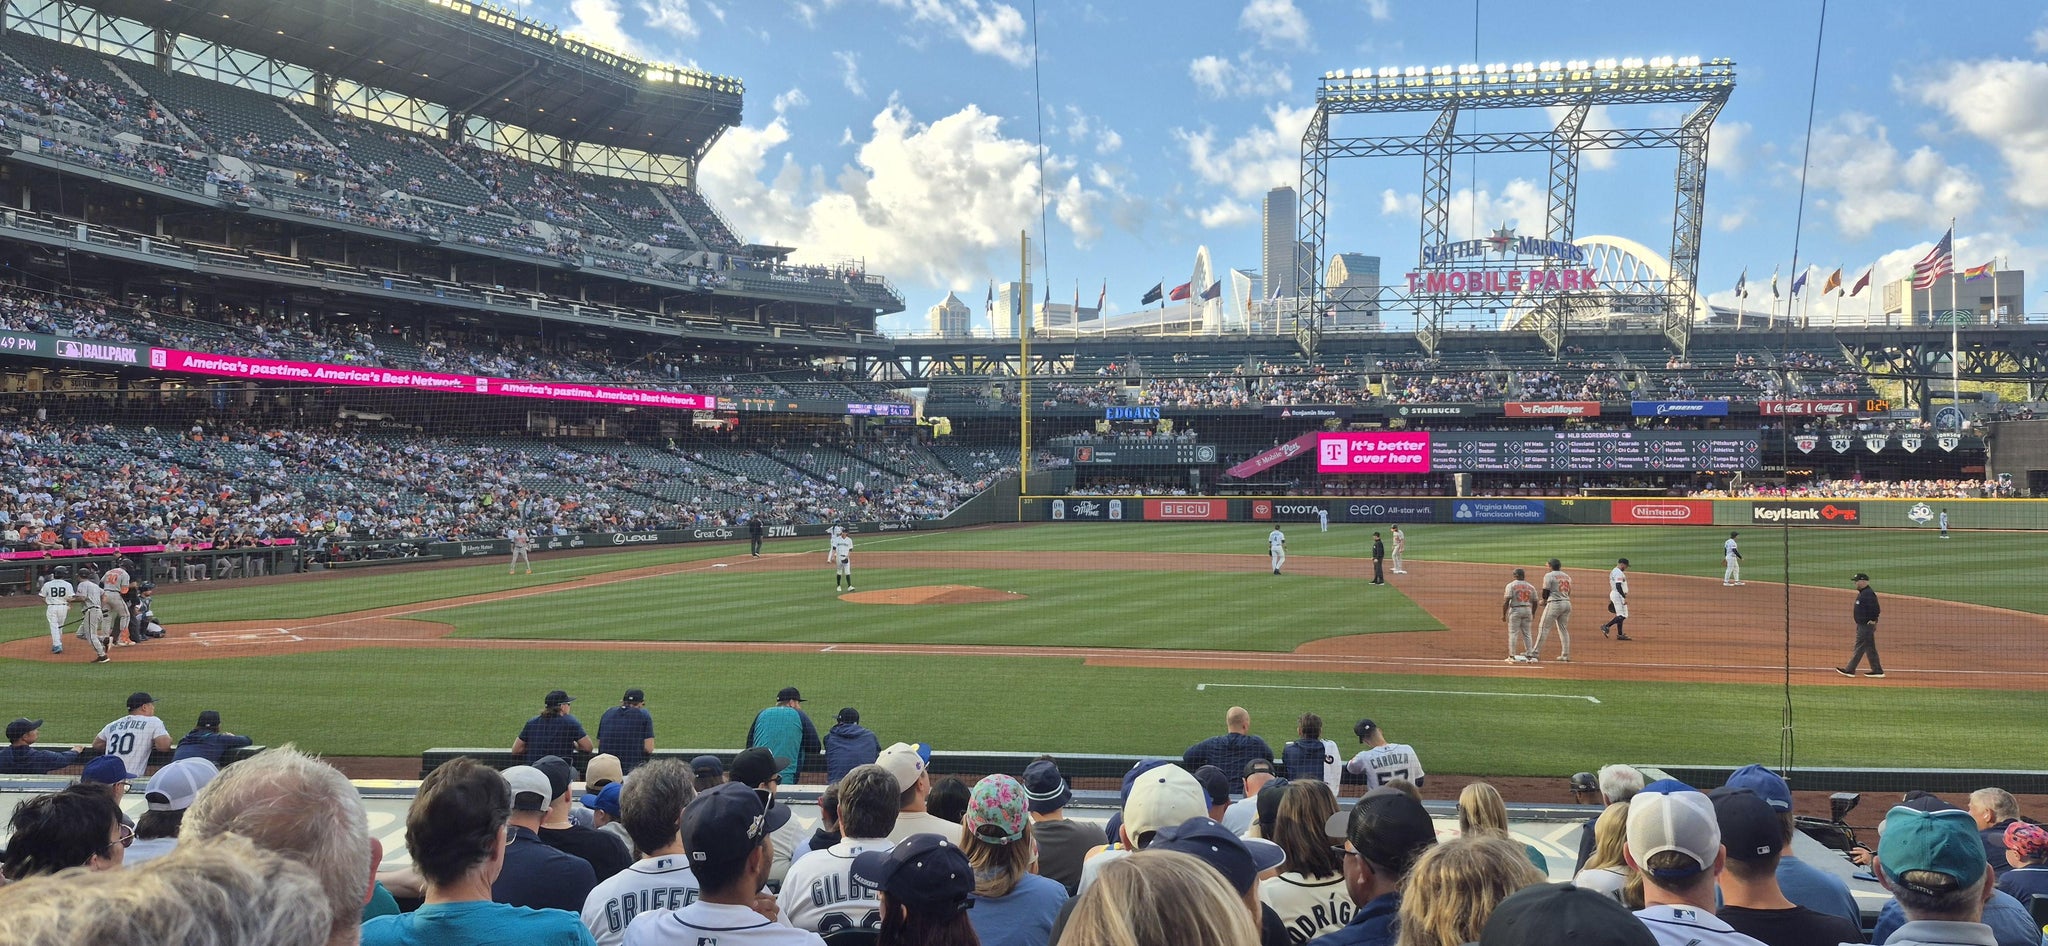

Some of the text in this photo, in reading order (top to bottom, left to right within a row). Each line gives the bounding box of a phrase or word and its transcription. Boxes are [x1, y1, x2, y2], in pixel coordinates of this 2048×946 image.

[1423, 235, 1585, 265] SEATTLE MARINERS
[770, 274, 809, 284] Trident Deck
[1404, 268, 1599, 294] T-MOBILE PARK
[18, 338, 37, 351] PM
[83, 343, 137, 363] BALLPARK
[183, 355, 464, 389] America's pastime. America's Best Network.
[501, 383, 697, 406] America's pastime. America's Best Network.
[1106, 407, 1160, 419] EDGARS
[1815, 403, 1846, 413] Coca-Cola
[1351, 440, 1426, 451] It's better
[1800, 441, 1813, 449] 42
[1835, 441, 1847, 449] 24
[1906, 440, 1917, 448] 51
[1943, 438, 1955, 447] 51
[1353, 453, 1423, 464] over here
[1164, 506, 1207, 515] BECU
[1275, 505, 1319, 514] TOYOTA
[1350, 505, 1385, 515] eero
[1754, 507, 1819, 521] KeyBank
[694, 528, 733, 540] Great Clips
[768, 525, 797, 537] STIHL
[625, 534, 658, 542] LEXUS
[51, 587, 66, 597] BB
[108, 732, 135, 755] 30
[853, 873, 879, 888] MARINERS
[811, 871, 880, 908] GILBE
[1287, 892, 1362, 944] ODRÍG
